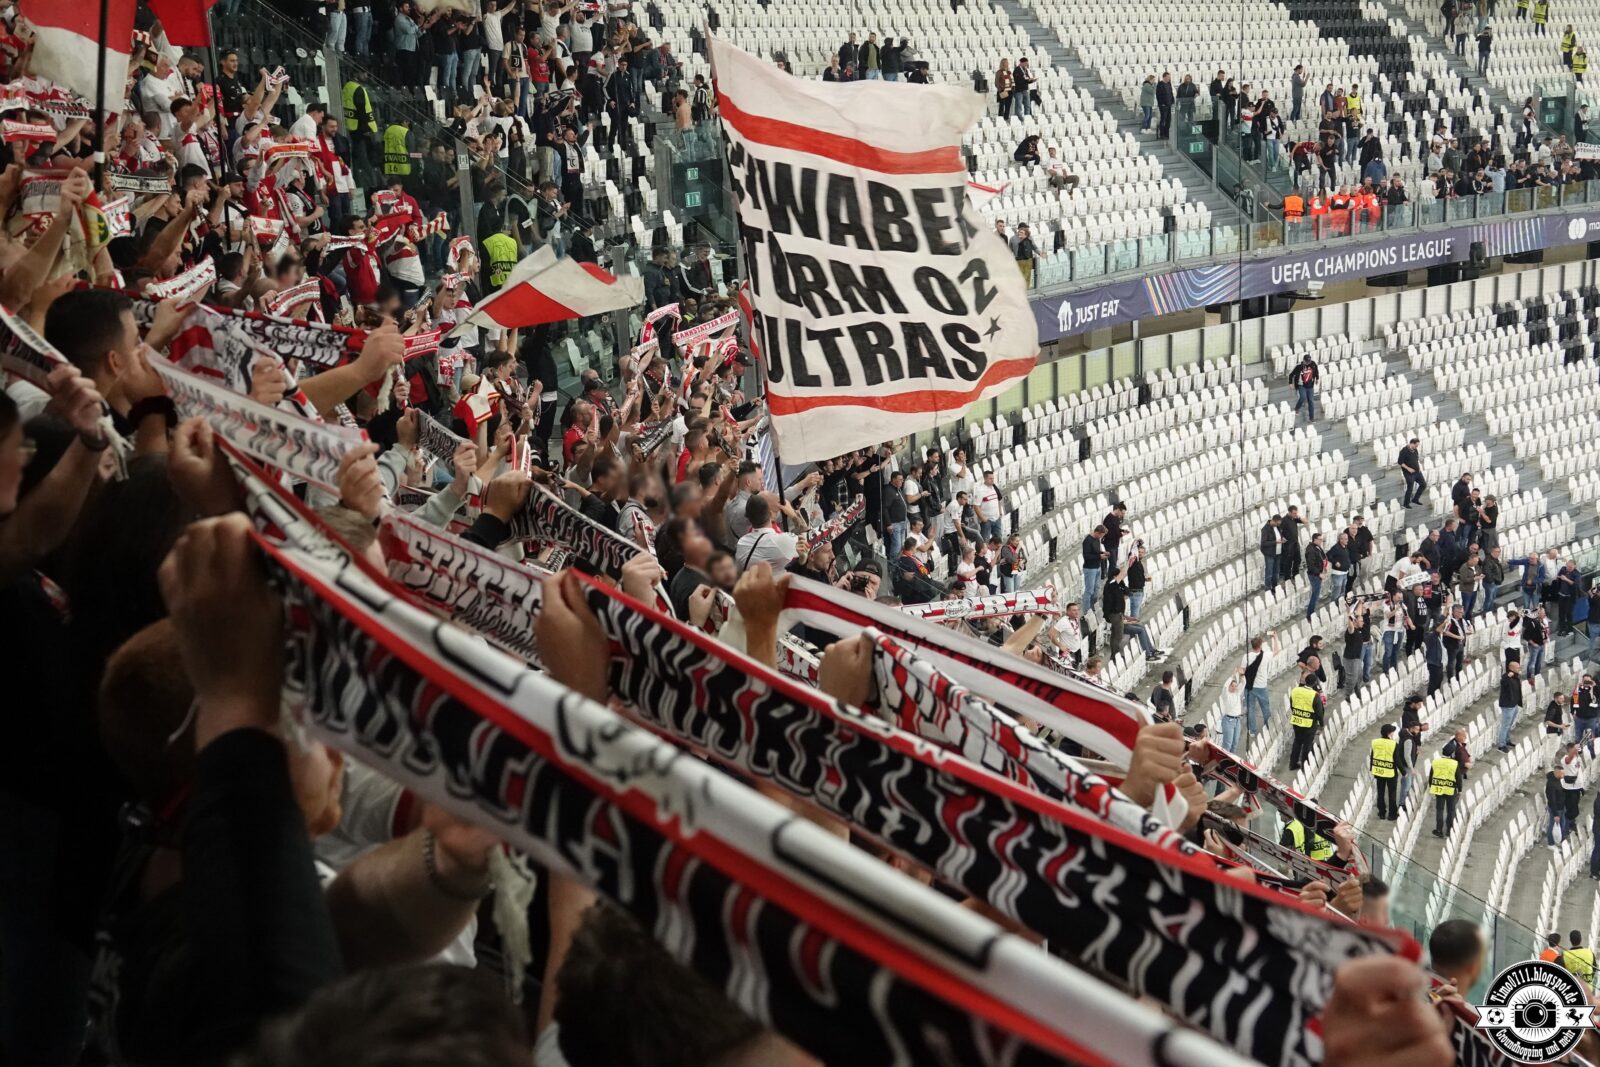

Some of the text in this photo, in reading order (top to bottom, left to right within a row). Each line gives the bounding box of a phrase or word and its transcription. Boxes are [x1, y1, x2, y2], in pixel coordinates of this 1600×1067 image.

[1271, 238, 1452, 284] UEFA CHAMPIONS LEAGUE
[1075, 299, 1120, 328] JUST EAT
[754, 310, 988, 387] ULTRAS
